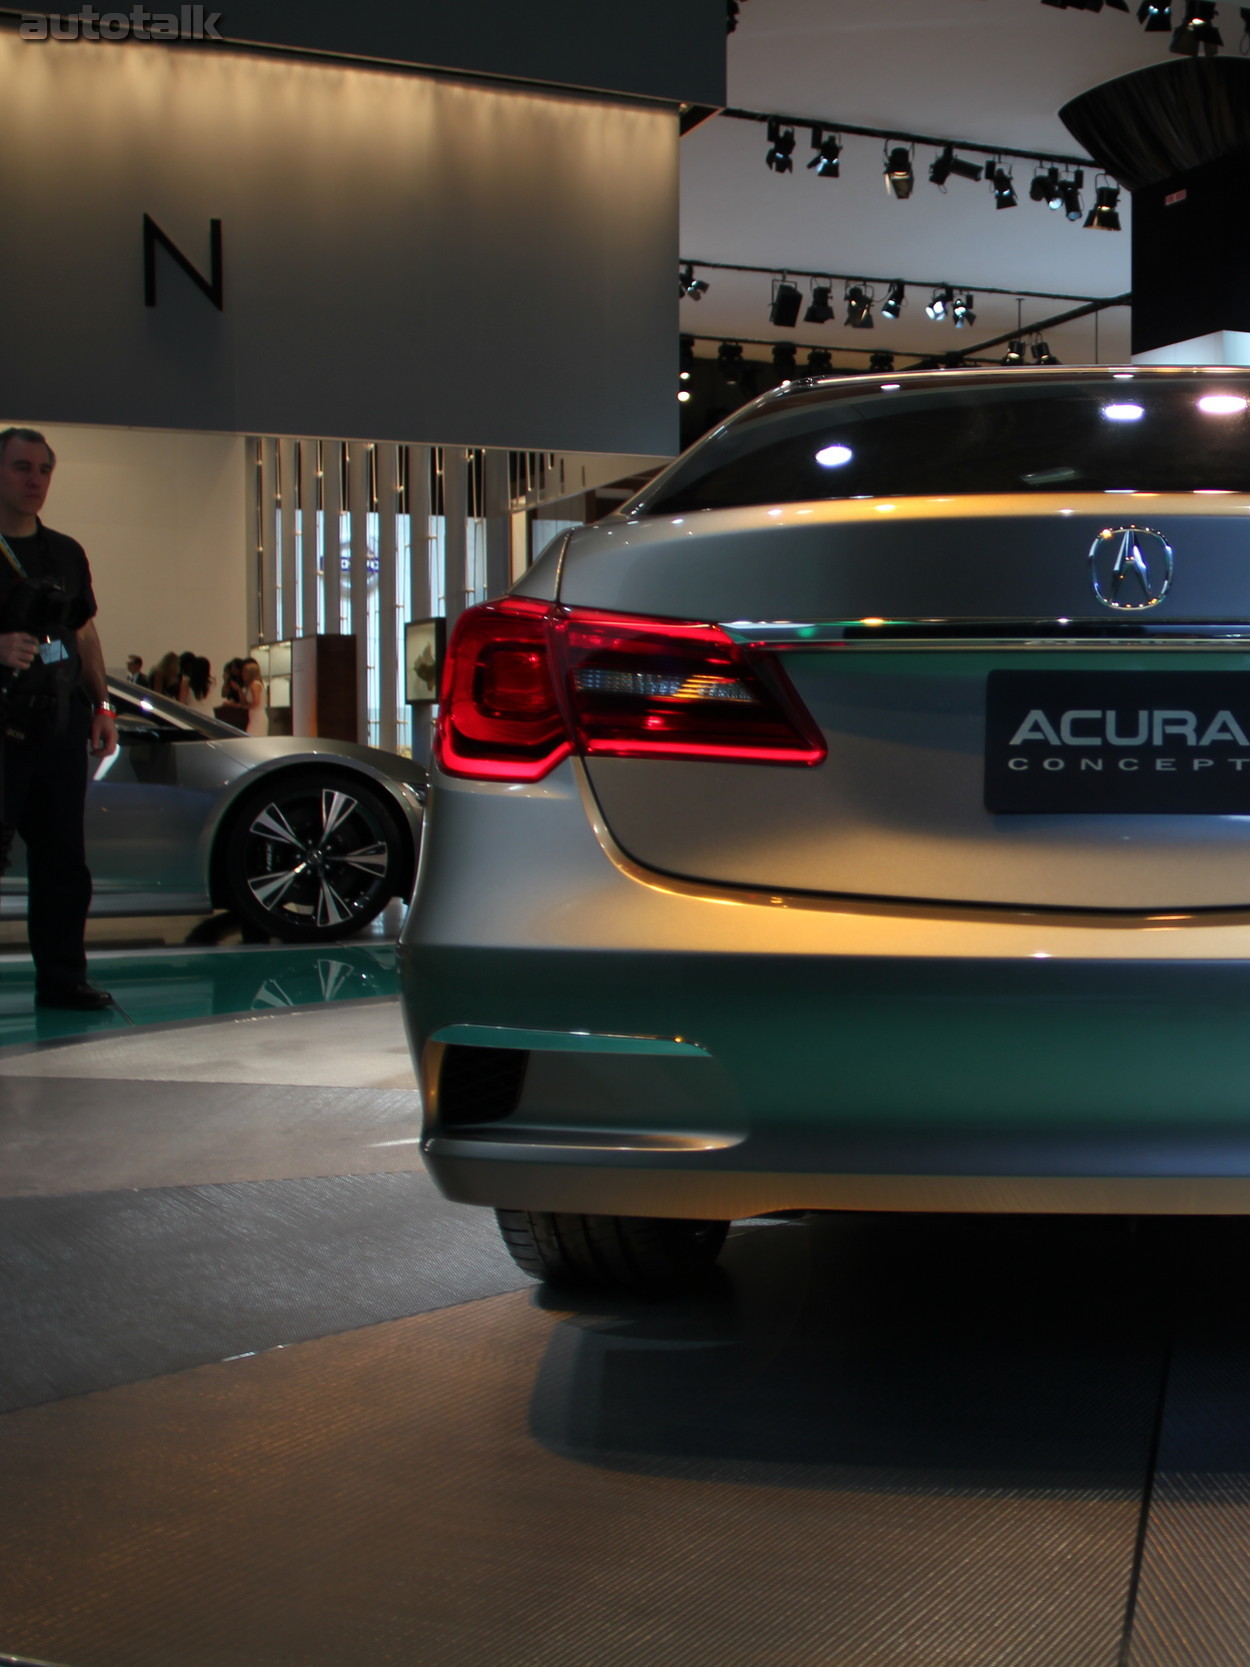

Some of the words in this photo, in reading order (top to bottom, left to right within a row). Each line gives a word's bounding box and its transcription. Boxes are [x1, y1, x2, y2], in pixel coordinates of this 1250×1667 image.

[143, 211, 223, 312] N
[1008, 709, 1250, 746] ACURA
[1007, 757, 1250, 771] CONCEPT
